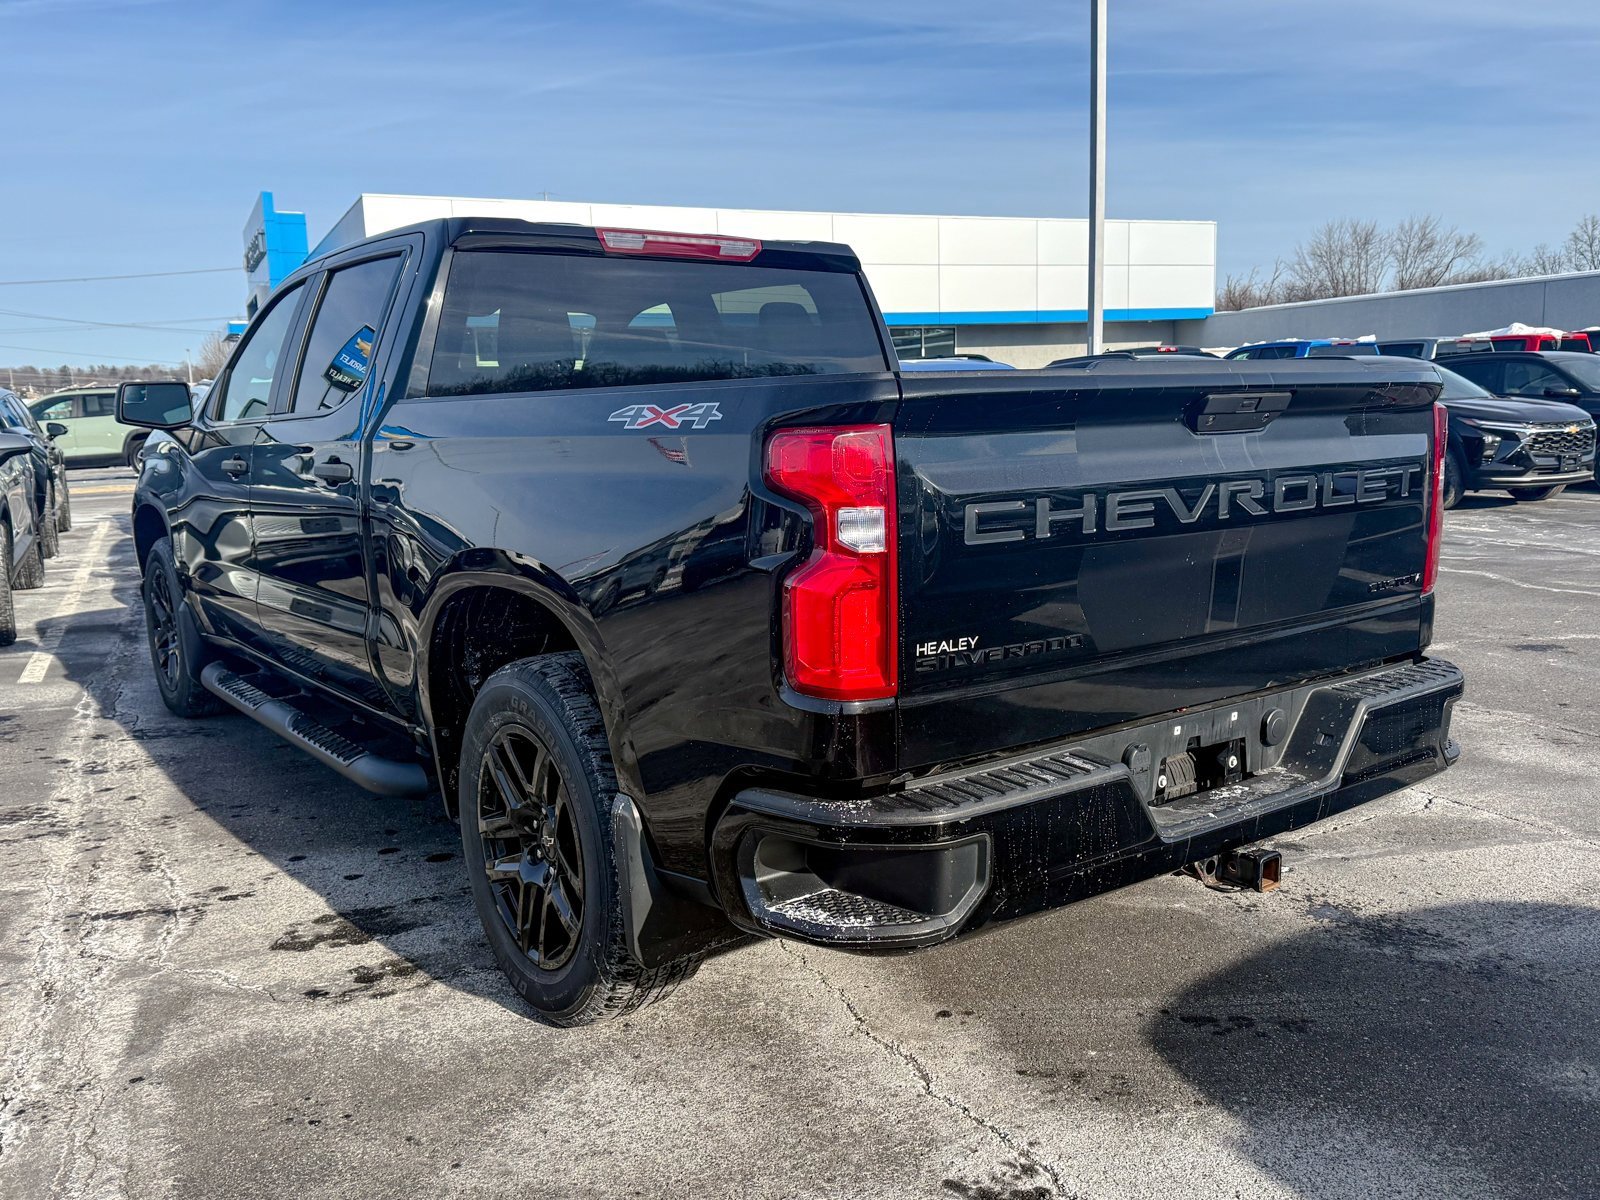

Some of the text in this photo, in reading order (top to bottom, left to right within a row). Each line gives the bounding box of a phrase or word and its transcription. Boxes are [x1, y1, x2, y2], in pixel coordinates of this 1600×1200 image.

[964, 464, 1421, 545] CHEVROLET
[914, 633, 1084, 673] SILVERADO
[916, 635, 979, 657] HEALEY
[510, 694, 573, 782] GRABBER
